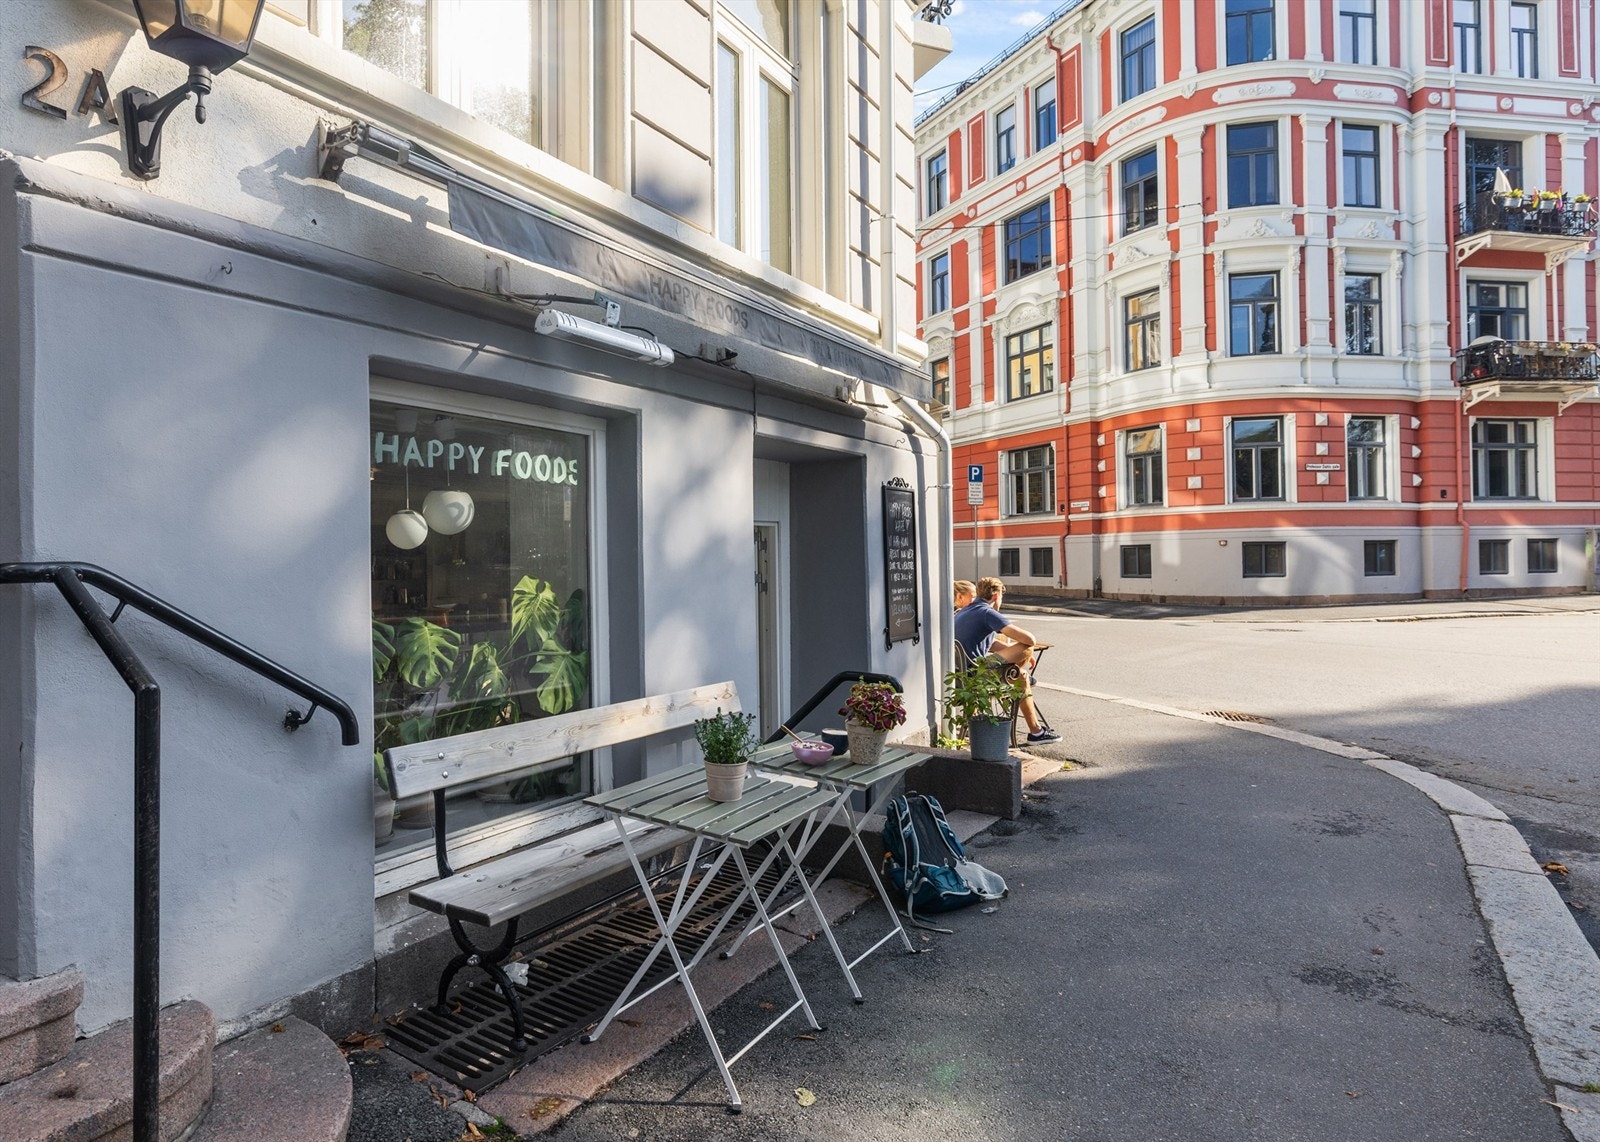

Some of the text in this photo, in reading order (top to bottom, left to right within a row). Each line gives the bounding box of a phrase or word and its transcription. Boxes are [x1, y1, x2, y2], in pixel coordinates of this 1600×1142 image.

[649, 274, 748, 329] HAPPY FOODS
[375, 432, 578, 485] HAPPY FOODS
[971, 467, 980, 480] P
